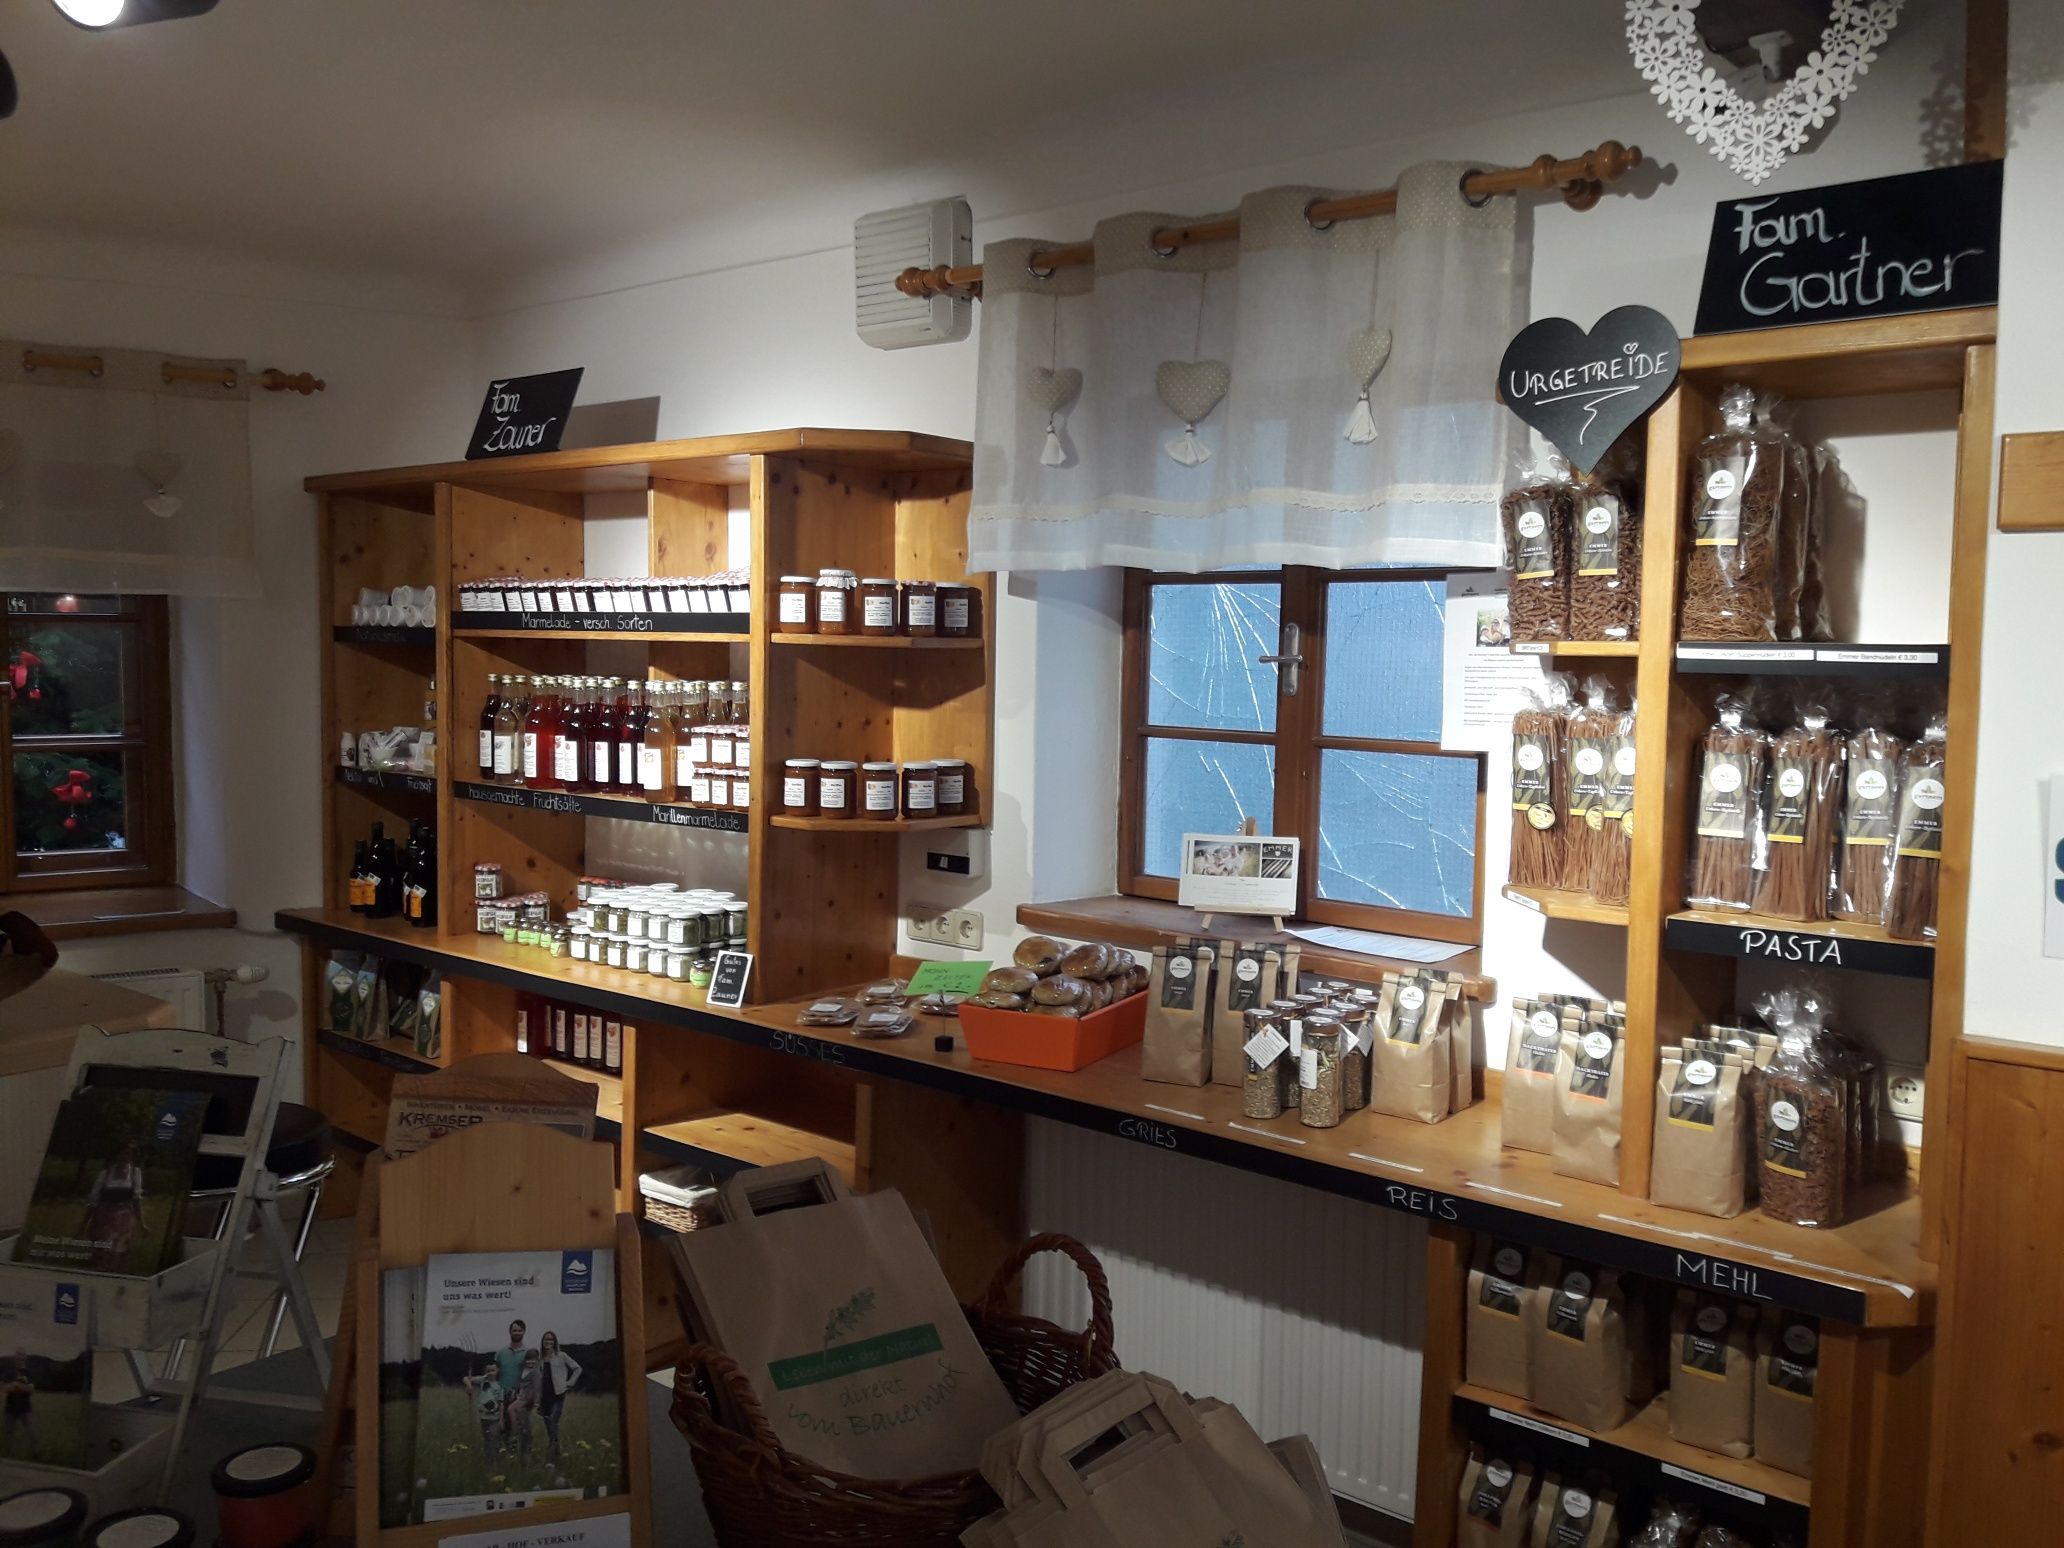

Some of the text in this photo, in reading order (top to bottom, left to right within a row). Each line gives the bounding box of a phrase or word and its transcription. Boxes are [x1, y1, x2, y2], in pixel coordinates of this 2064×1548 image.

[1734, 198, 1846, 254] Fam.
[1740, 237, 1985, 316] Gartner
[483, 416, 557, 452] Zauner
[522, 612, 572, 629] Marmelade
[582, 615, 612, 630] versch.
[617, 614, 653, 630] Sorten
[1263, 845, 1294, 854] EMMER
[1740, 929, 1842, 965] PASTA
[444, 1275, 535, 1288] Unsere Wiesen sind
[1677, 1253, 1773, 1300] MEHL
[463, 1292, 482, 1300] was
[485, 1290, 512, 1299] wert!
[839, 1376, 903, 1409] direkt
[537, 1533, 584, 1545] VERKAUF
